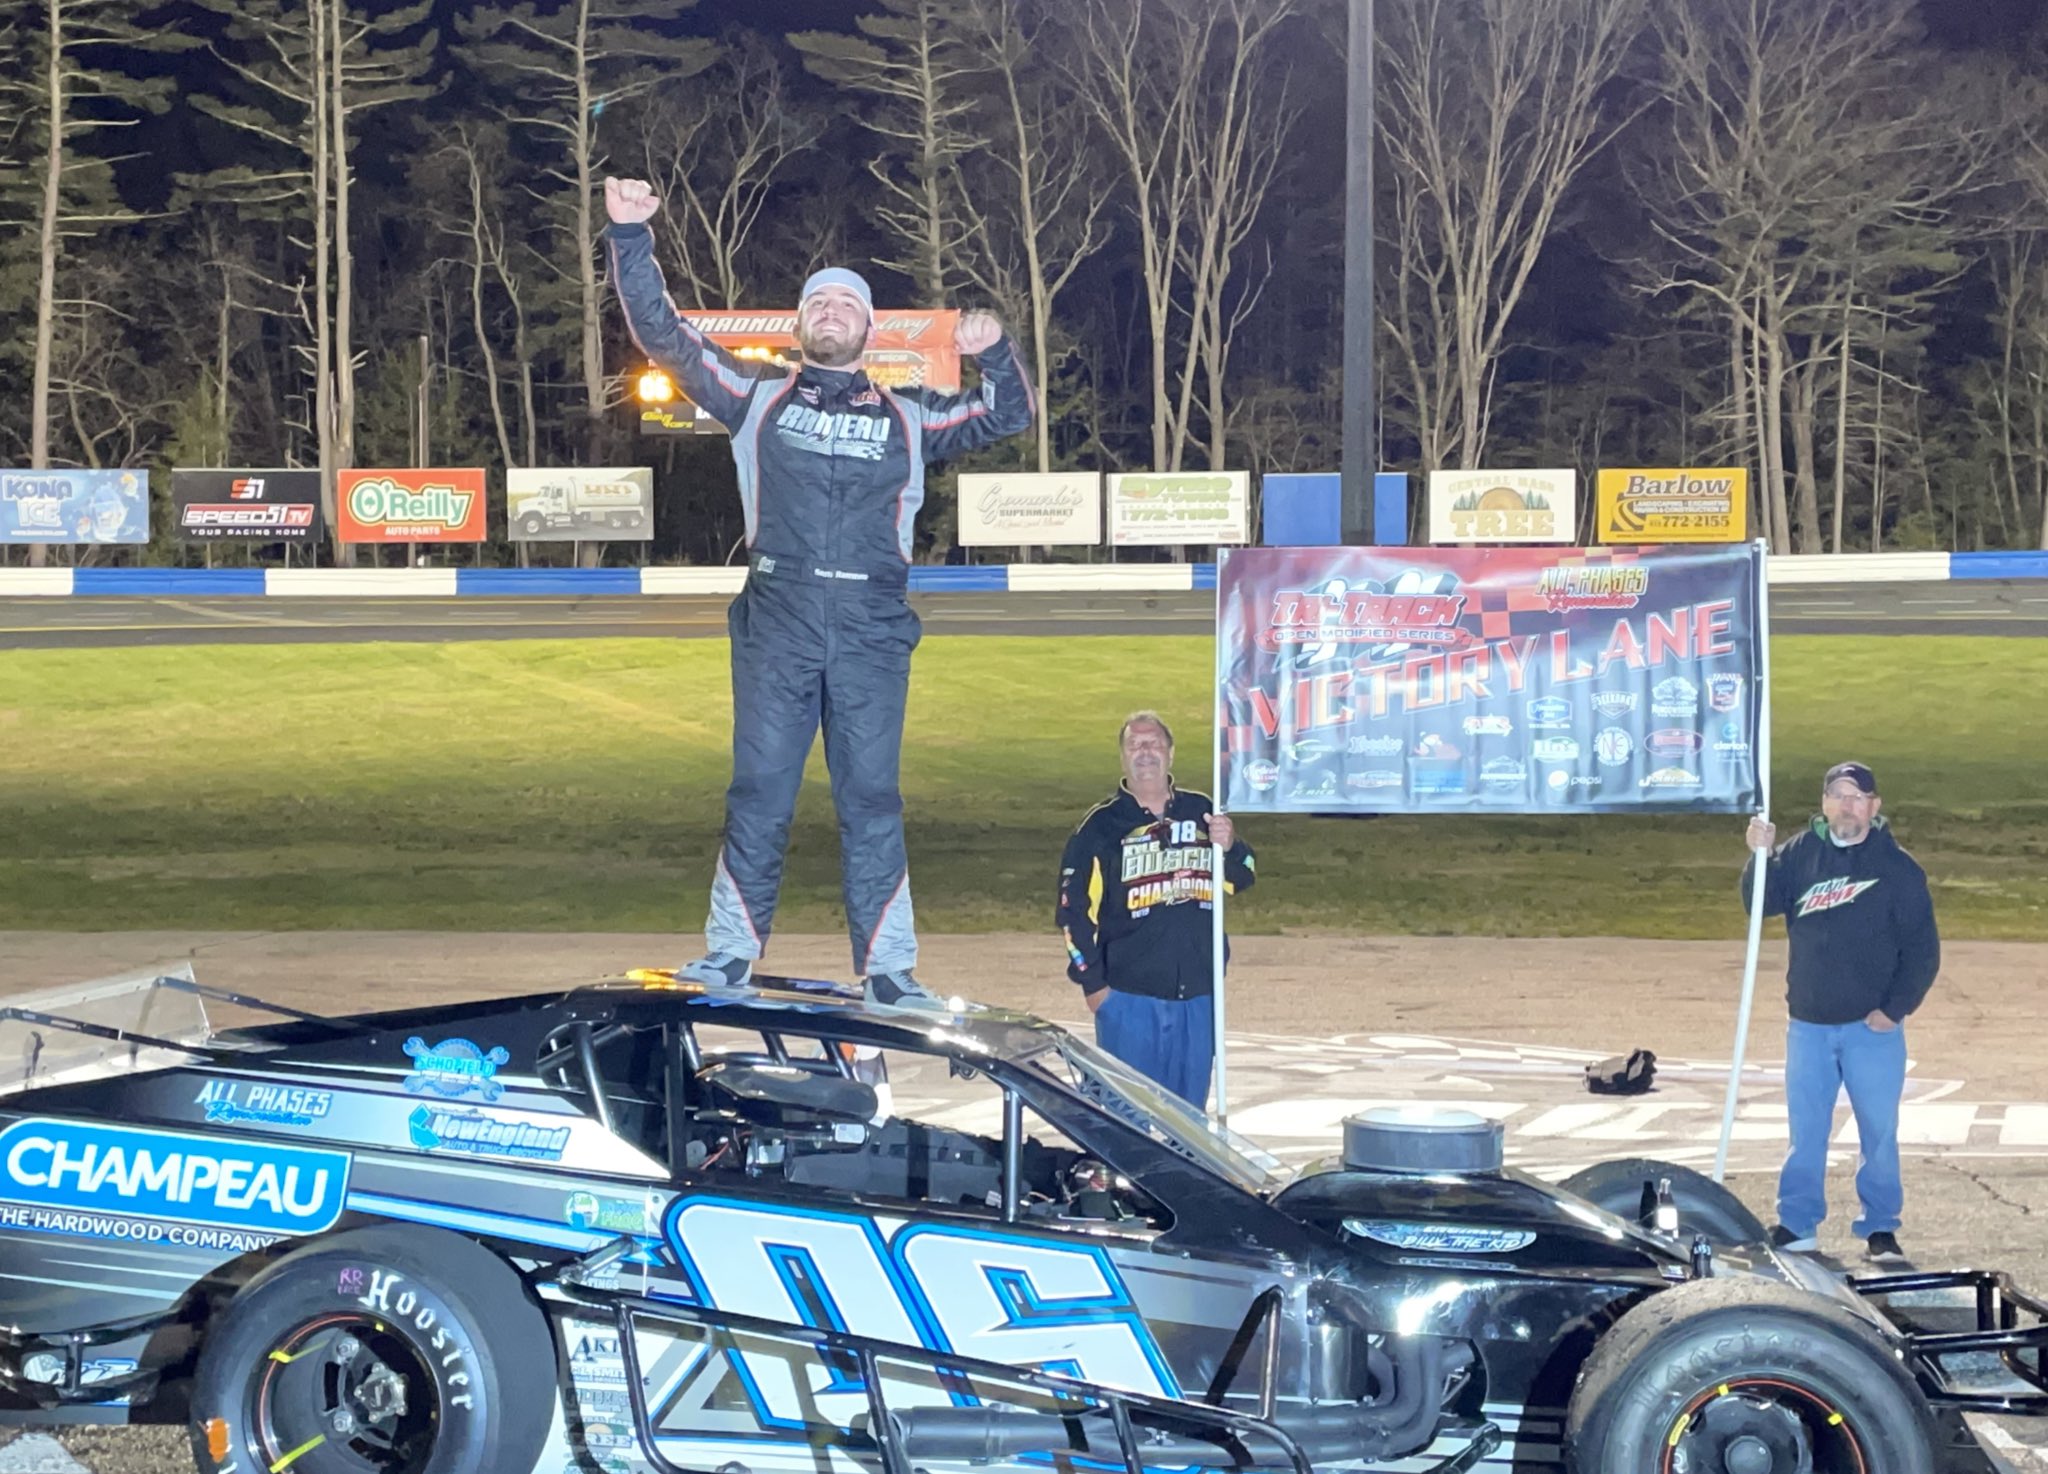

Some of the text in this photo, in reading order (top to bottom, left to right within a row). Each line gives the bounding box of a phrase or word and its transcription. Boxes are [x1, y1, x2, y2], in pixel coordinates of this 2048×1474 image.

[776, 404, 891, 441] RAMEAU
[4, 478, 72, 499] KONA
[1625, 474, 1733, 496] Barlow
[18, 499, 61, 526] ICE
[354, 480, 470, 525] O'Reilly
[999, 509, 1073, 517] SUPERMARKET
[385, 527, 440, 536] AUTO PARTS
[1450, 510, 1555, 537] TREE
[1662, 515, 1730, 528] 772-2155
[1575, 567, 1650, 595] PHASES
[1274, 628, 1455, 641] OPEN MODIFIED SERIES
[1248, 597, 1736, 740] VICTORY LANE
[1570, 776, 1602, 786] pepsi
[1170, 820, 1196, 844] 18
[1123, 840, 1160, 857] KYLE
[1121, 847, 1212, 882] BUSCH
[1127, 877, 1213, 910] CHAMPION
[194, 1080, 331, 1116] ALL PHASES
[446, 1139, 468, 1150] AUTO
[479, 1143, 508, 1154] TRUCK
[7, 1136, 329, 1217] CHAMPEAU
[0, 1208, 276, 1251] THE HARDWOOD COMPANY
[1449, 1236, 1491, 1249] THE
[1488, 1239, 1521, 1250] KID
[340, 1268, 363, 1285] RR
